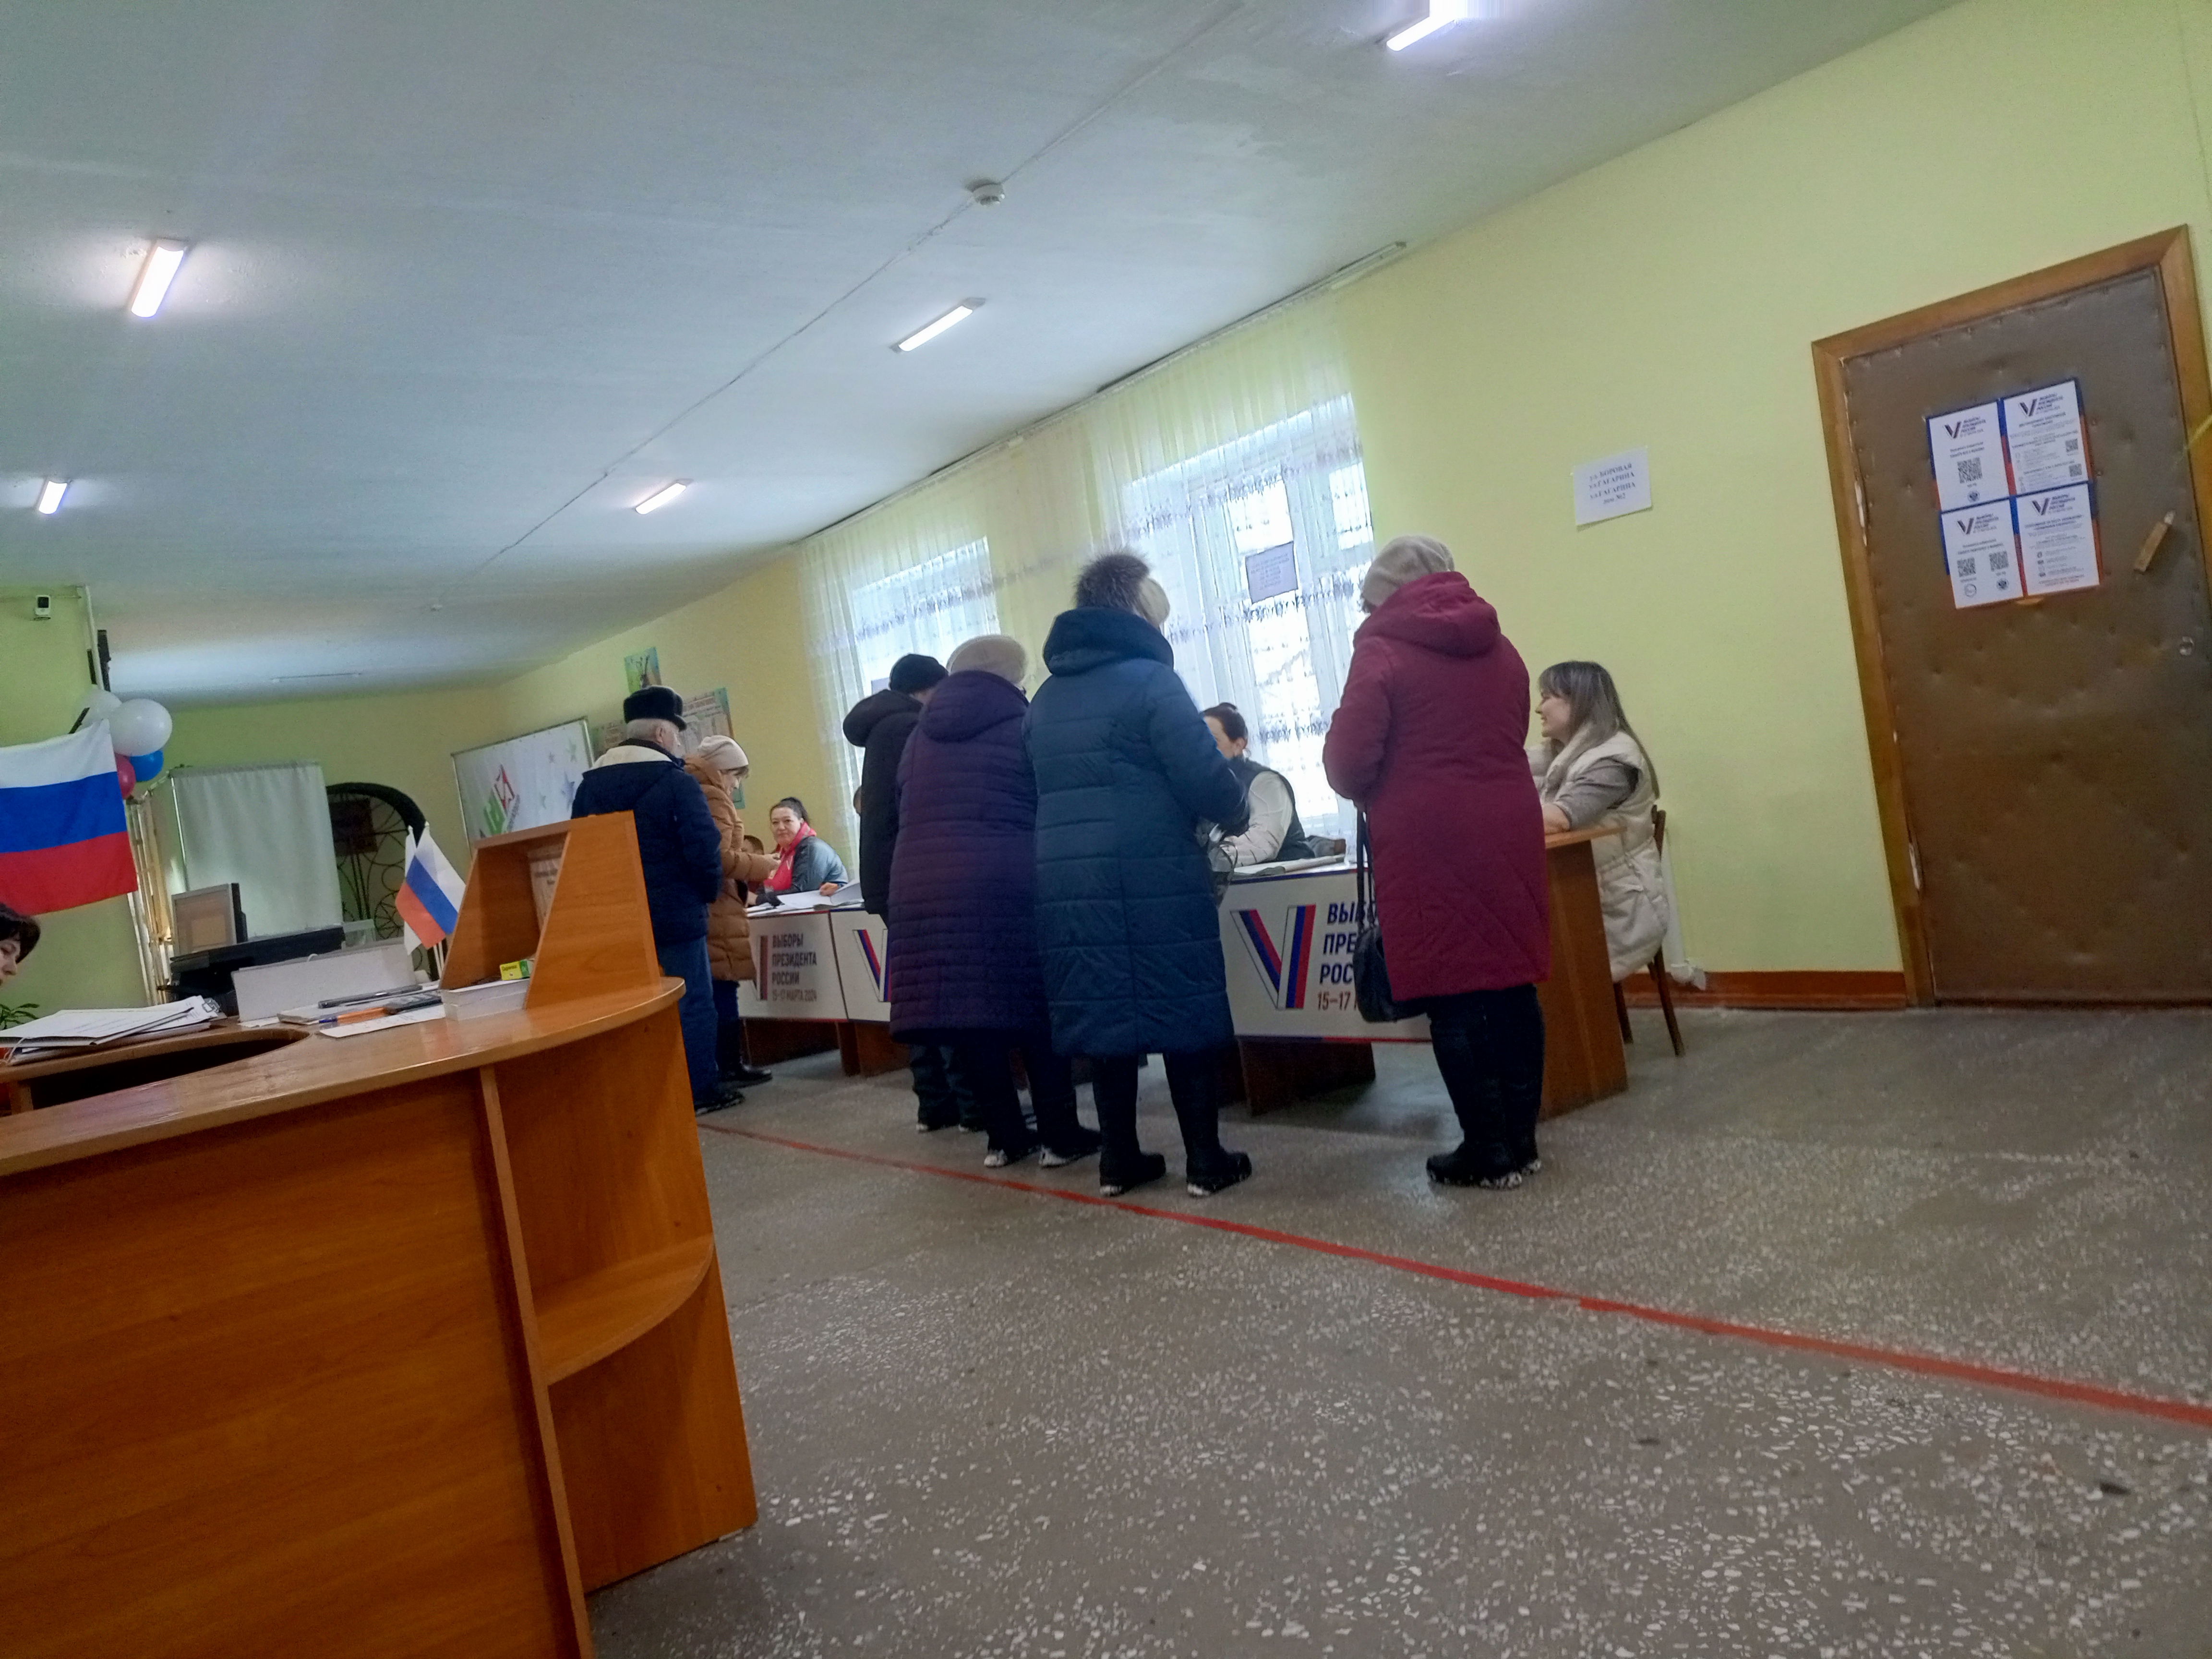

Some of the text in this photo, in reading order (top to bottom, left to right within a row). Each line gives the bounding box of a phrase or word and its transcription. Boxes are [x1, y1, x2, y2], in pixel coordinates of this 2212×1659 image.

[772, 933, 804, 948] ВЫБОРЫ
[1323, 932, 1357, 955] ПРЕ
[772, 951, 817, 969] ПРЕЗИДЕНТА
[772, 971, 800, 985] РОССИИ
[1320, 962, 1354, 985] РОС
